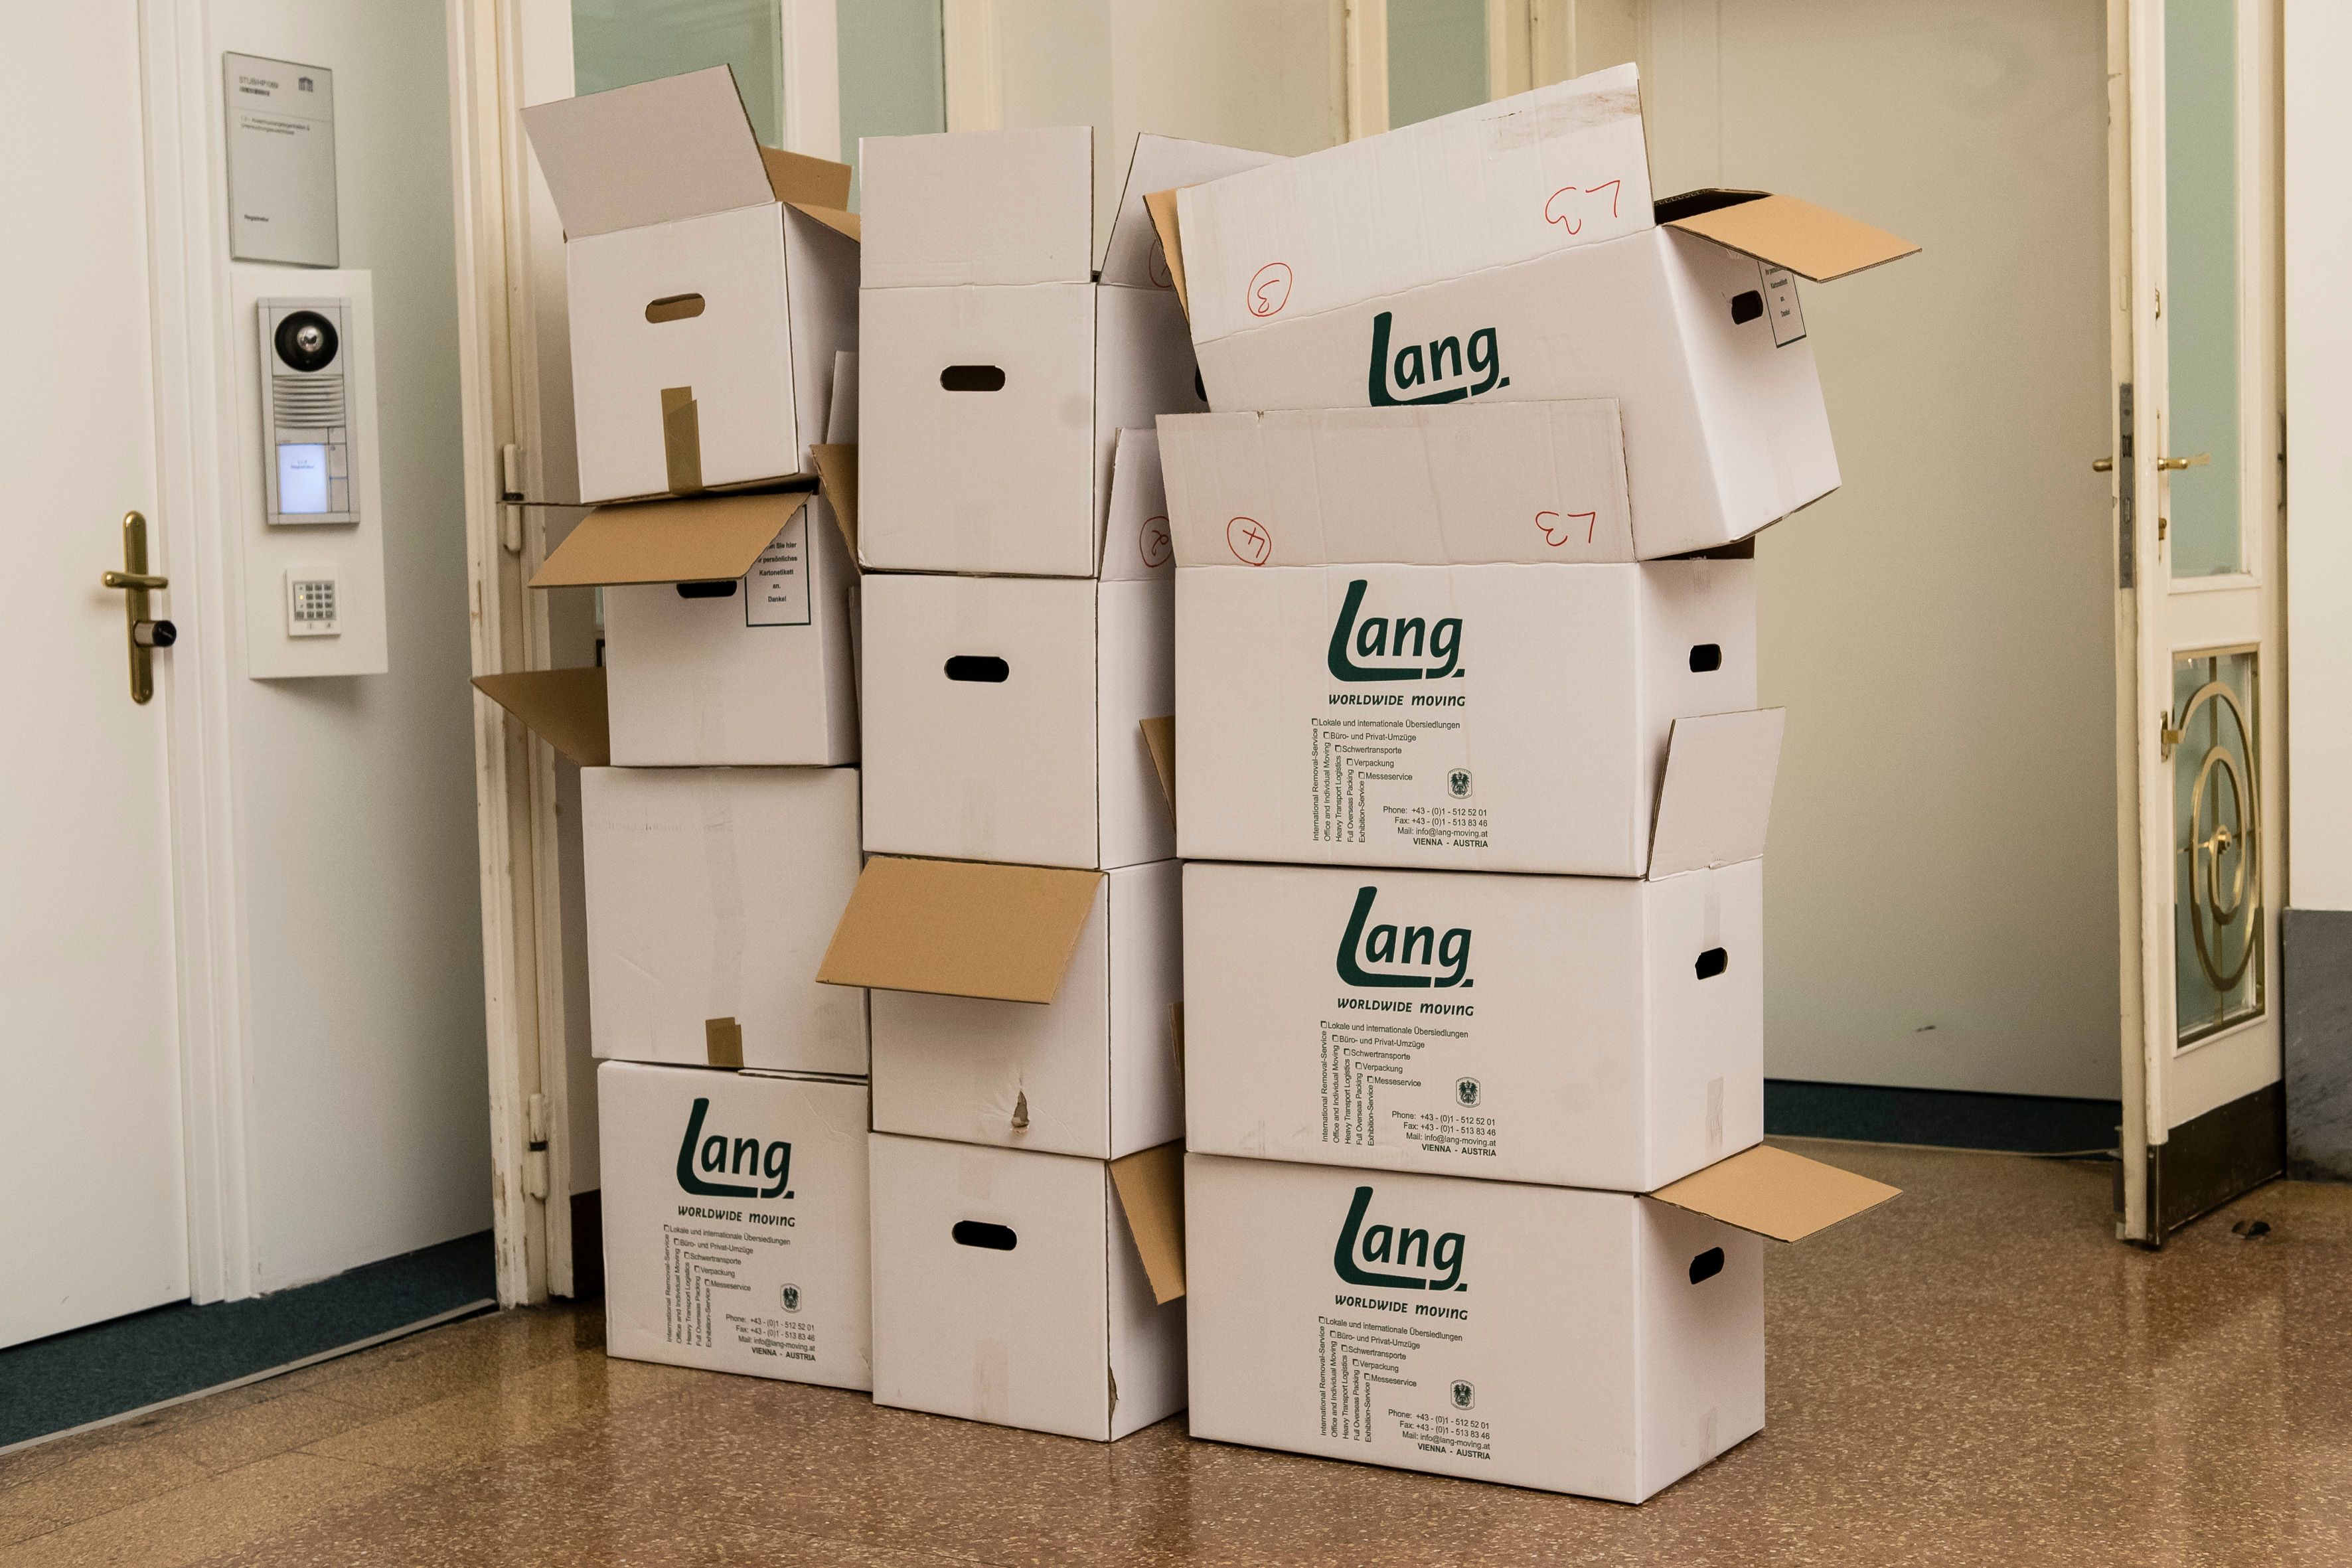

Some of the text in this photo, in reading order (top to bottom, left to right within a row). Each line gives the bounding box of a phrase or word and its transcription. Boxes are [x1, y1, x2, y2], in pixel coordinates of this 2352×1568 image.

[1328, 694, 1404, 706] WORLDWIDE
[1318, 718, 1342, 727] Lokale
[1357, 719, 1404, 728] internationale
[1405, 719, 1460, 730] Übersiedlungen
[1366, 732, 1417, 743] Privat-Umzüge
[1322, 742, 1332, 768] Moving
[1342, 745, 1402, 755] Schwertransporte
[1353, 758, 1394, 769] Verpackung
[1366, 772, 1413, 781] Messeservice
[1334, 755, 1344, 842] Heavy Transport Logistics
[1383, 805, 1407, 814] Phone:
[1468, 808, 1477, 817] 52
[1395, 816, 1410, 824] Fax:
[1452, 818, 1466, 826] 513
[1468, 819, 1477, 827] 83
[1397, 826, 1488, 840] Mail: info@lang-moving.at
[1413, 837, 1488, 848] VIENNA AUSTRIA
[1338, 998, 1413, 1013] WORLDWIDE
[1328, 1021, 1350, 1030] Lokale
[1366, 1024, 1413, 1034] internationale
[1413, 1026, 1468, 1040] Übersiedlungen
[1374, 1038, 1425, 1050] Privat-Umzüge
[1332, 1045, 1340, 1071] Moving
[1351, 1049, 1411, 1061] Schwertransporte
[1362, 1062, 1403, 1075] Verpackung
[1355, 1073, 1364, 1099] Packing
[1374, 1076, 1422, 1087] Messeservice
[1343, 1058, 1353, 1144] Heavy Transport Logistics
[1366, 1084, 1375, 1146] Exhibition-Service
[1391, 1110, 1416, 1120] Phone:
[1460, 1116, 1474, 1125] 512
[1486, 1118, 1495, 1127] 01
[1403, 1121, 1419, 1130] Fax:
[1460, 1126, 1474, 1135] 513
[1476, 1127, 1485, 1136] 83
[1406, 1132, 1496, 1148] Mail: info@lang-moving.at
[1421, 1143, 1497, 1157] VIENNA AUSTRIA
[678, 1205, 743, 1222] WORLDWIDE
[1335, 1294, 1408, 1313] WORLDWIDE
[1325, 1317, 1348, 1327] Lokale
[1363, 1322, 1408, 1335] internationale
[1409, 1326, 1463, 1342] Übersiedlungen
[1370, 1336, 1421, 1350] Privat-Umzüge
[1348, 1346, 1407, 1360] Schwertransporte
[1341, 1355, 1350, 1384] Logistics
[1360, 1360, 1399, 1373] Verpackung
[1352, 1370, 1361, 1396] Packing
[1371, 1373, 1417, 1387] Messeservice
[1388, 1409, 1412, 1419] Phone:
[1455, 1418, 1469, 1427] 512
[1470, 1420, 1479, 1429] 52
[1480, 1421, 1489, 1430] 01
[1399, 1420, 1415, 1429] Fax:
[1455, 1428, 1469, 1437] 513
[1470, 1430, 1480, 1439] 83
[1402, 1430, 1490, 1450] Mail: info@lang-moving.at
[1417, 1443, 1491, 1460] VIENNA AUSTRIA
